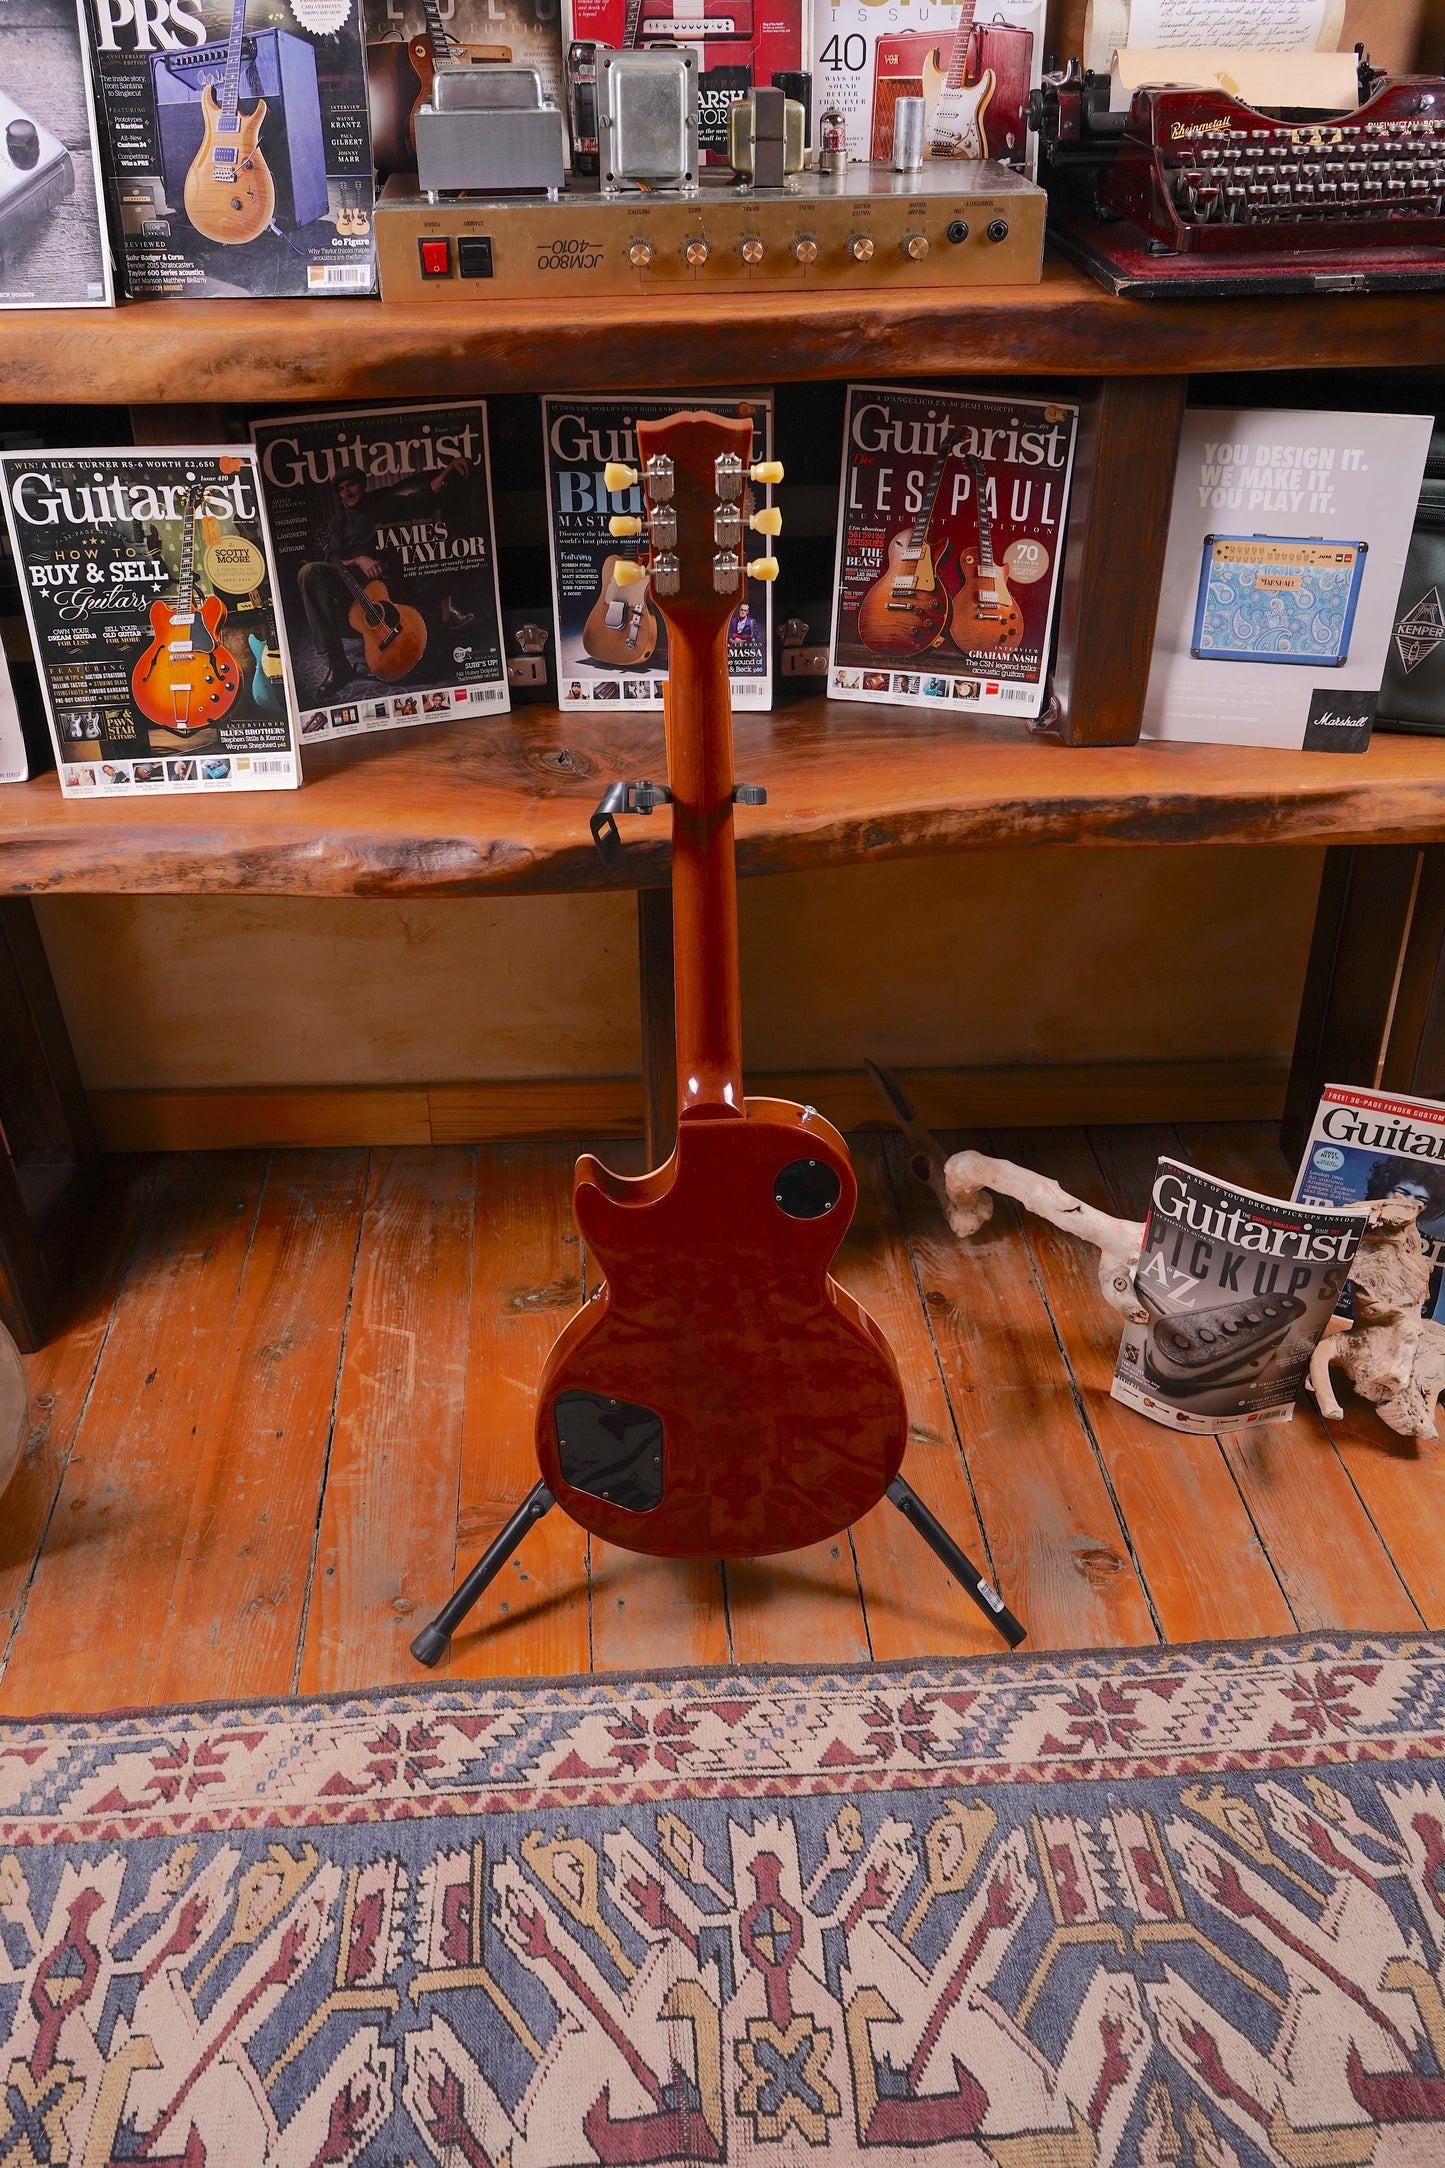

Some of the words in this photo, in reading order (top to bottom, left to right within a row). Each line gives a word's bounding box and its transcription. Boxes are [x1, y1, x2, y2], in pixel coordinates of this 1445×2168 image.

[831, 8, 957, 24] ISSUE
[97, 0, 207, 51] PRS
[818, 33, 867, 72] 40
[884, 54, 900, 65] VOX
[112, 75, 129, 83] inside
[115, 90, 142, 98] Singlecut
[114, 116, 143, 124] Prototypes
[1171, 115, 1231, 140] Rheinmetall
[331, 138, 363, 146] GILBERT
[118, 153, 150, 162] Competition
[331, 238, 343, 246] Go
[344, 238, 370, 247] Figure
[141, 254, 161, 262] Badger
[537, 254, 604, 270] JCM800
[187, 277, 207, 285] Bellamy
[884, 395, 934, 405] D'ANGELICO
[983, 404, 1015, 413] WORTH
[852, 404, 1066, 468] Guitarist
[263, 424, 481, 488] Guitarist
[853, 452, 875, 465] The
[1204, 443, 1249, 466] YOU
[1254, 445, 1335, 470] DESIGN
[1340, 448, 1368, 471] IT.
[78, 461, 119, 469] TURNER
[1200, 464, 1234, 487] WE
[1238, 466, 1302, 491] MAKE
[1307, 470, 1335, 492] IT.
[849, 466, 925, 513] LES
[951, 474, 1055, 525] PAUL
[1198, 486, 1243, 510] YOU
[1248, 488, 1305, 512] PLAY
[1309, 491, 1337, 514] IT.
[275, 516, 307, 526] THOMPSON
[277, 531, 307, 540] LANDRETH
[376, 521, 448, 551] JAMES
[597, 538, 619, 546] players
[848, 539, 885, 548] REISSUES
[55, 550, 99, 561] HOW
[112, 547, 137, 558] TO
[215, 549, 250, 557] SCOTTY
[279, 544, 306, 553] SATRIANI
[397, 536, 486, 565] TAYLOR
[859, 547, 884, 558] THE
[1017, 544, 1039, 561] 70
[217, 556, 251, 564] MOORE
[560, 552, 593, 561] Featuring
[418, 562, 440, 571] private
[440, 559, 466, 568] acoustic
[846, 557, 883, 568] BEAST
[28, 563, 80, 586] BUY
[86, 562, 105, 584] &
[109, 560, 169, 582] SELL
[423, 565, 459, 575] songwriting
[460, 563, 480, 571] legend
[1261, 578, 1297, 588] MARSHALL
[53, 584, 152, 621] Guitars
[1397, 625, 1444, 638] KEMPER
[48, 634, 72, 642] DREAM
[995, 645, 1039, 654] INTERVIEW
[968, 650, 1010, 662] GRAHAM
[1012, 653, 1038, 664] NASH
[50, 664, 125, 674] FEATURING
[464, 660, 487, 669] SURF'S
[965, 659, 978, 667] The
[979, 660, 994, 668] CSN
[995, 661, 1019, 671] legend
[1020, 664, 1037, 672] talks
[972, 667, 1001, 675] acoustic
[1001, 670, 1025, 679] guitars
[55, 696, 74, 704] PRE-BUY
[74, 695, 98, 703] CHECKLIST
[123, 709, 132, 718] &
[107, 718, 135, 727] PAWN
[227, 721, 285, 729] INTERVIEWED
[1313, 711, 1369, 728] Marshall
[108, 726, 136, 735] STAR
[220, 729, 244, 737] BLUES
[244, 727, 286, 736] BROTHERS
[220, 736, 246, 744] Stephen
[225, 743, 248, 751] Wayne
[249, 742, 277, 750] Shepherd
[1328, 1092, 1348, 1102] FREE!
[1383, 1103, 1412, 1115] FENDER
[1413, 1109, 1445, 1122] CUSTOM
[1310, 1170, 1330, 1179] London
[1307, 1180, 1334, 1189] American
[1317, 1177, 1344, 1186] unknown
[1167, 1164, 1185, 1176] WIN!
[1194, 1176, 1208, 1188] SET
[1210, 1185, 1221, 1193] OF
[1223, 1190, 1245, 1203] YOUR
[1248, 1199, 1279, 1214] DREAM
[1282, 1209, 1321, 1220] PICKUPS
[1152, 1174, 1360, 1262] Guitarist
[1164, 1216, 1190, 1233] ESSENTIAL
[1273, 1220, 1301, 1231] MAGAZINE
[1147, 1218, 1342, 1301] PICKUPS
[1140, 1250, 1170, 1288] A
[1167, 1269, 1200, 1309] Z
